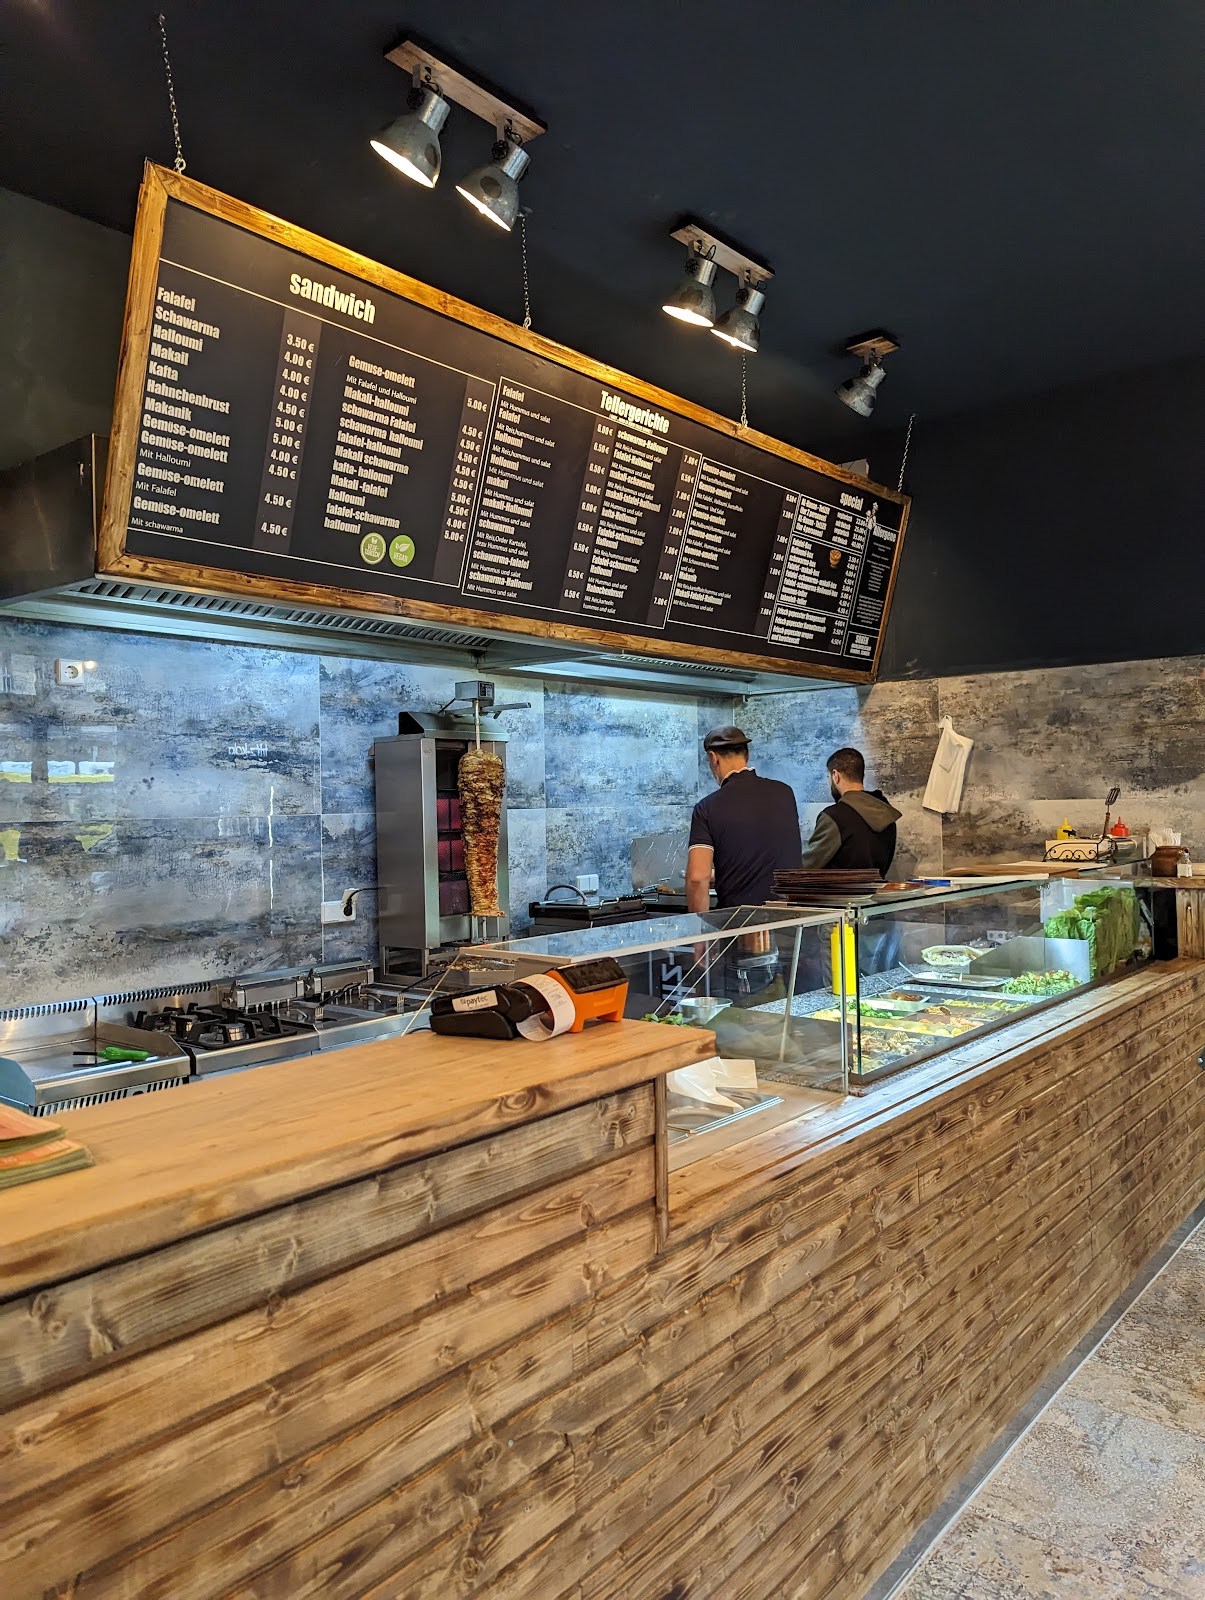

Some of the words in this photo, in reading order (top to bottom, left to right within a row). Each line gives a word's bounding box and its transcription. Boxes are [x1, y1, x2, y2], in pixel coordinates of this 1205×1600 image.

[157, 286, 195, 311] Falafel
[154, 305, 220, 339] Schawarma
[152, 323, 203, 351] Halloumi
[148, 360, 178, 381] Kafta
[345, 374, 357, 384] Mit
[357, 378, 377, 391] Falafel
[378, 386, 390, 395] und
[390, 389, 417, 404] Halloumi
[502, 384, 524, 402] Falafel
[144, 396, 191, 421] Makanik
[341, 402, 389, 425] schawarma
[498, 407, 520, 424] Falafel
[339, 417, 387, 439] schawarma
[388, 430, 423, 450] halloumi
[139, 447, 153, 458] Mit
[155, 451, 191, 467] Halloumi
[363, 454, 409, 474] schawarma
[135, 480, 149, 491] Mit
[151, 483, 176, 496] Falafel
[130, 516, 143, 526] Mit
[144, 520, 183, 533] schawarma
